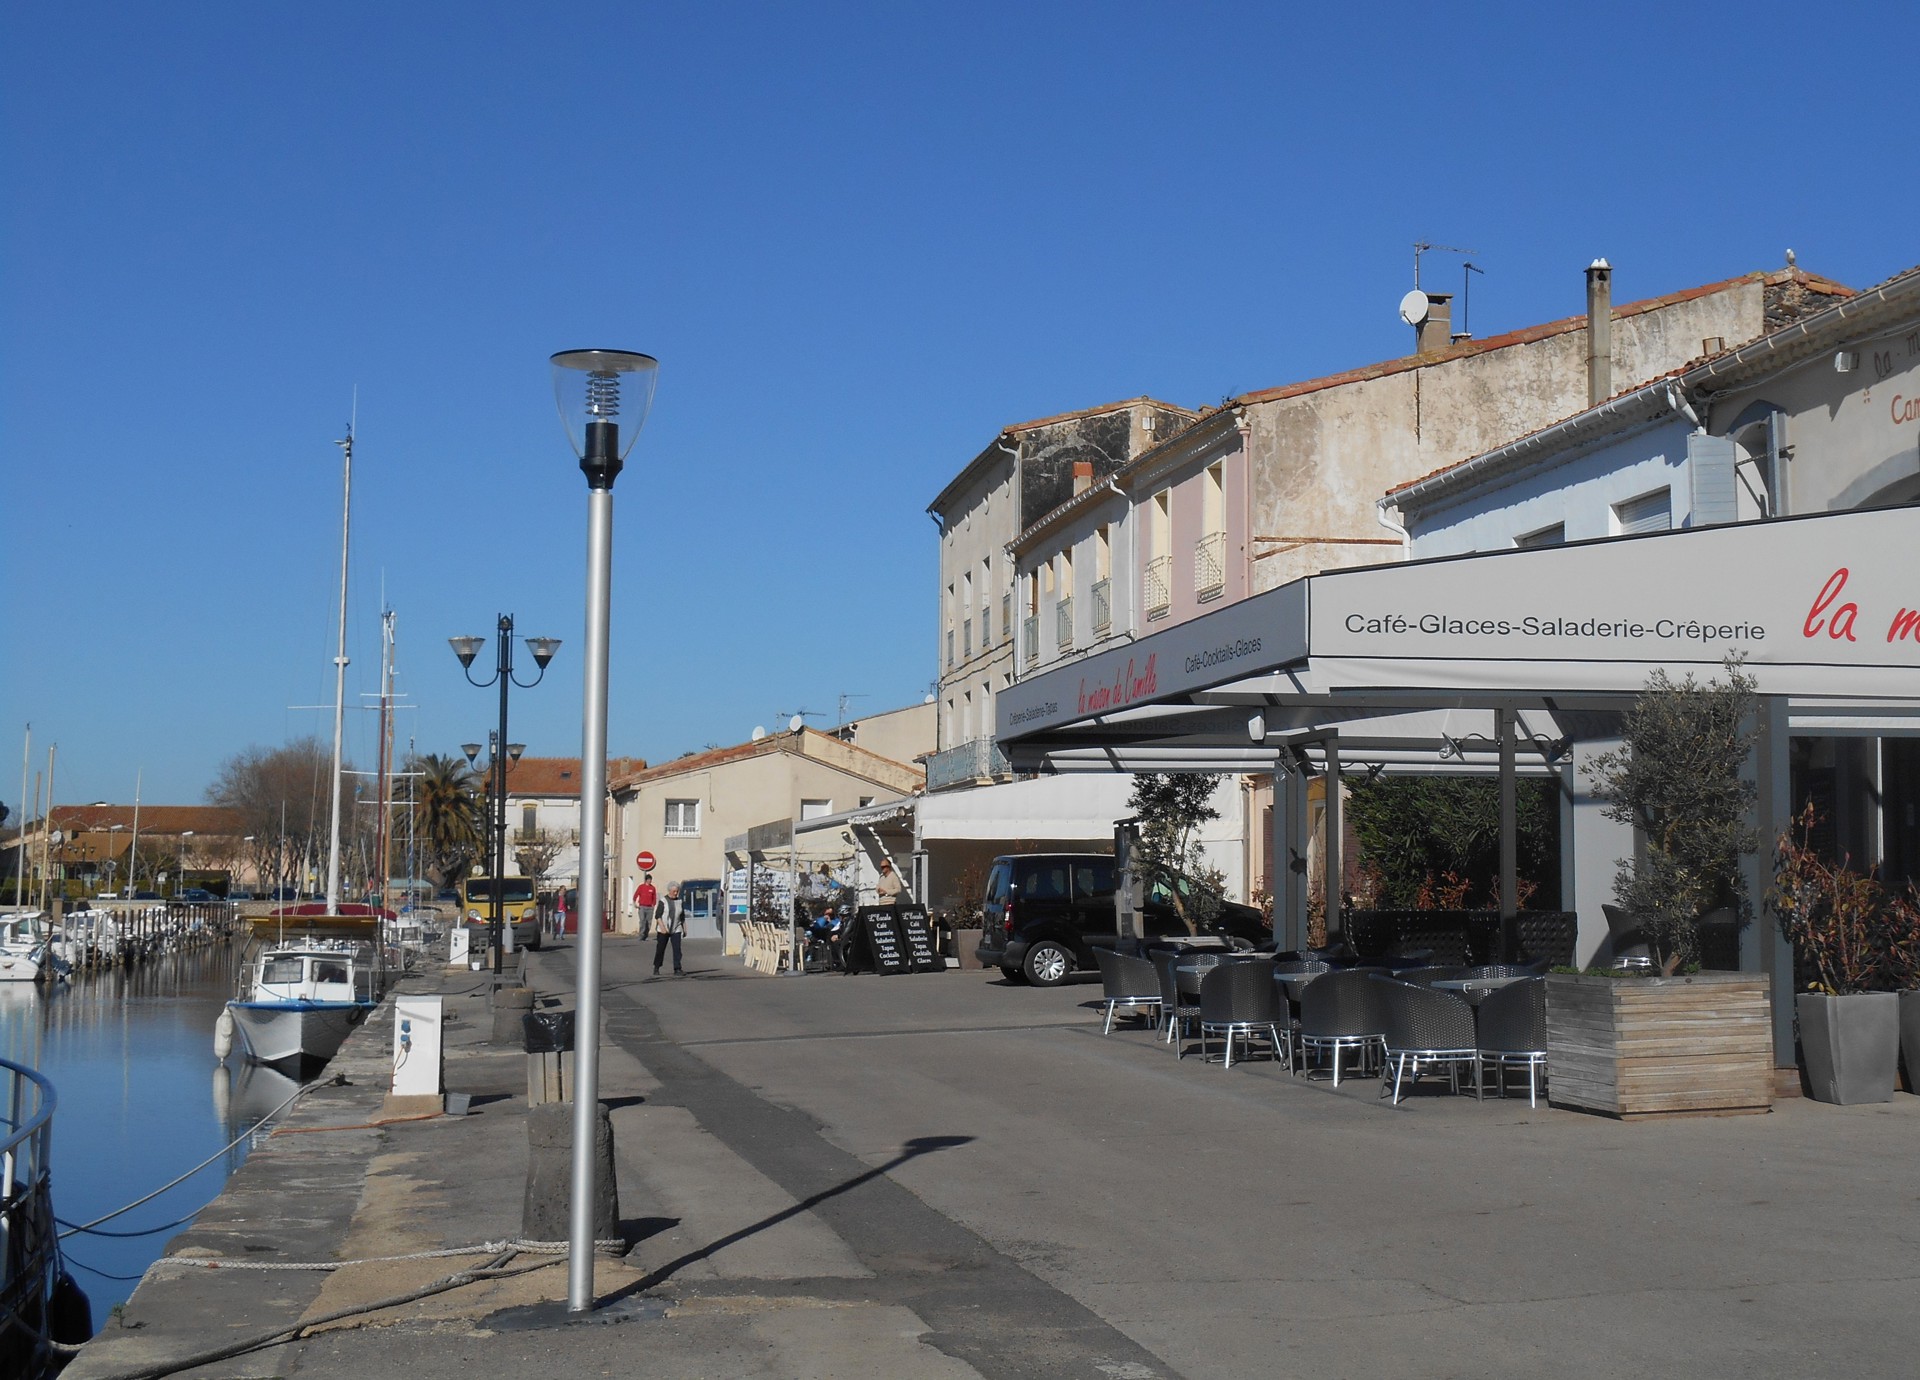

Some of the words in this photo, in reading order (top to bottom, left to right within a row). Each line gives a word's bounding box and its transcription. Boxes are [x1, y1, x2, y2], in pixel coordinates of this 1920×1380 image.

[1803, 567, 1858, 643] la
[1344, 612, 1766, 644] Café-Glaces-Saladerie-Crêperie
[1185, 637, 1262, 674] Café-Cocktails-Glaces
[1078, 678, 1086, 714] la
[1088, 681, 1110, 711] maison
[1113, 667, 1122, 704] de
[1125, 653, 1157, 704] Camille
[879, 951, 900, 959] Cocktails
